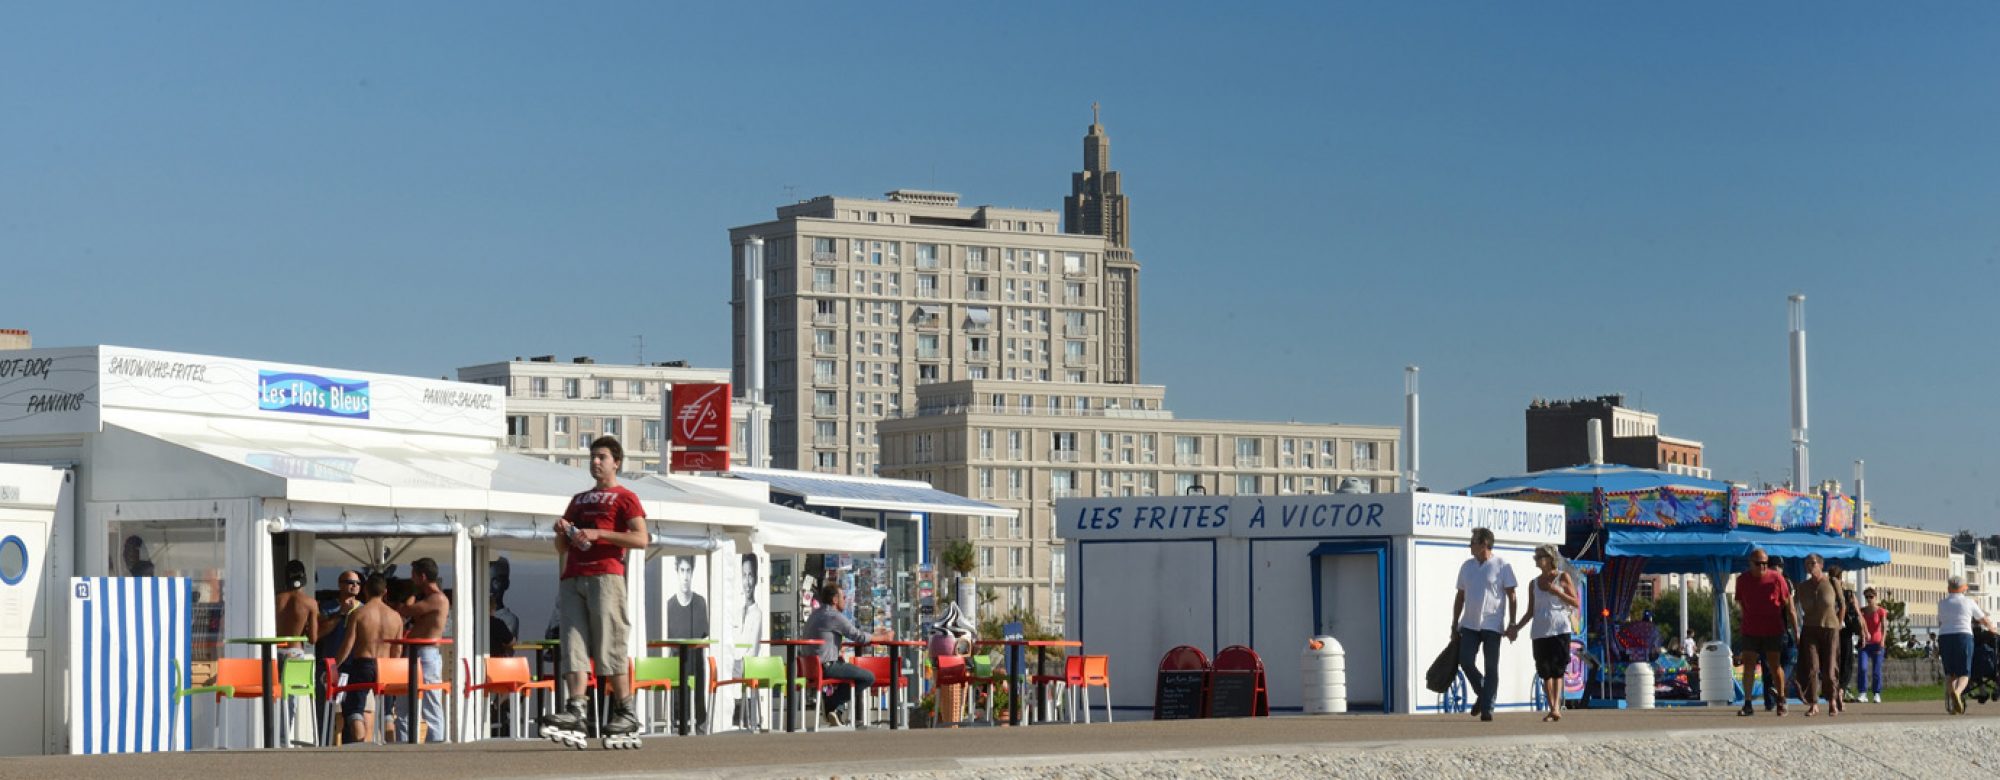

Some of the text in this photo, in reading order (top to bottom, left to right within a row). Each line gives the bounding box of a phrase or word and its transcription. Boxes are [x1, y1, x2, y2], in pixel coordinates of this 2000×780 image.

[0, 357, 53, 380] OT-DOG
[27, 392, 85, 413] PANINIS
[262, 379, 368, 412] Les Flots Bleus
[1077, 498, 1384, 530] LES FRITES À VICTOR
[1416, 503, 1433, 526] LES
[1435, 504, 1465, 528] FRITES
[1477, 507, 1509, 531] VICTOR
[1512, 510, 1542, 534] DEPUIS
[1544, 512, 1563, 536] 1927
[78, 585, 87, 596] 12
